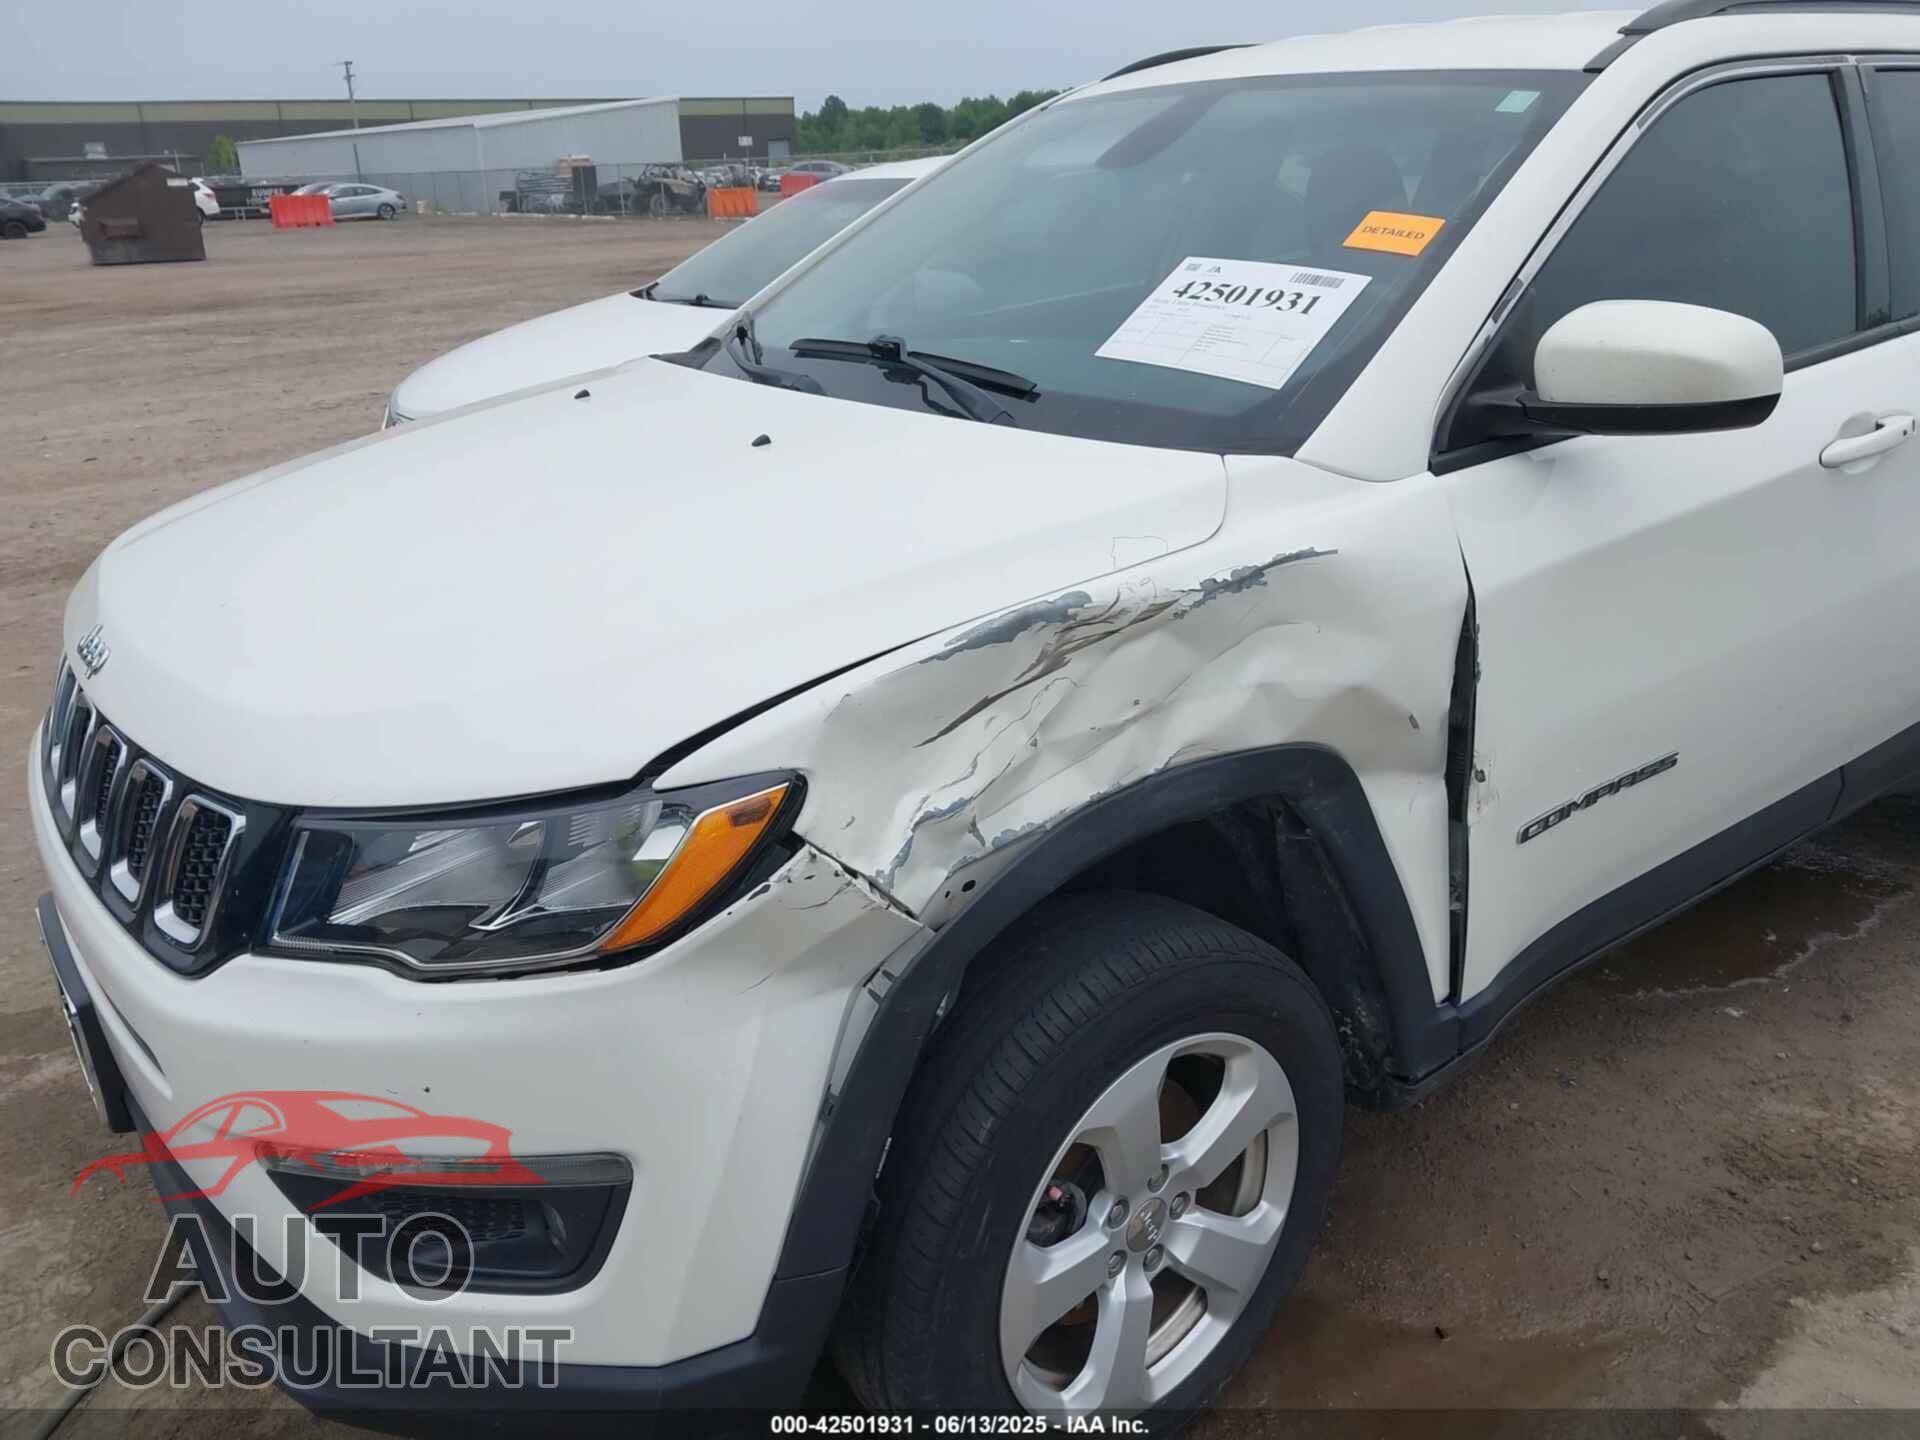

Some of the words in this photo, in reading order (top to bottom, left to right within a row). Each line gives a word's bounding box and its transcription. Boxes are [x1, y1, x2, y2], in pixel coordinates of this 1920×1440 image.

[1361, 225, 1425, 240] DETAILED
[1172, 280, 1322, 315] 42501931
[1516, 751, 1679, 844] COMPASS
